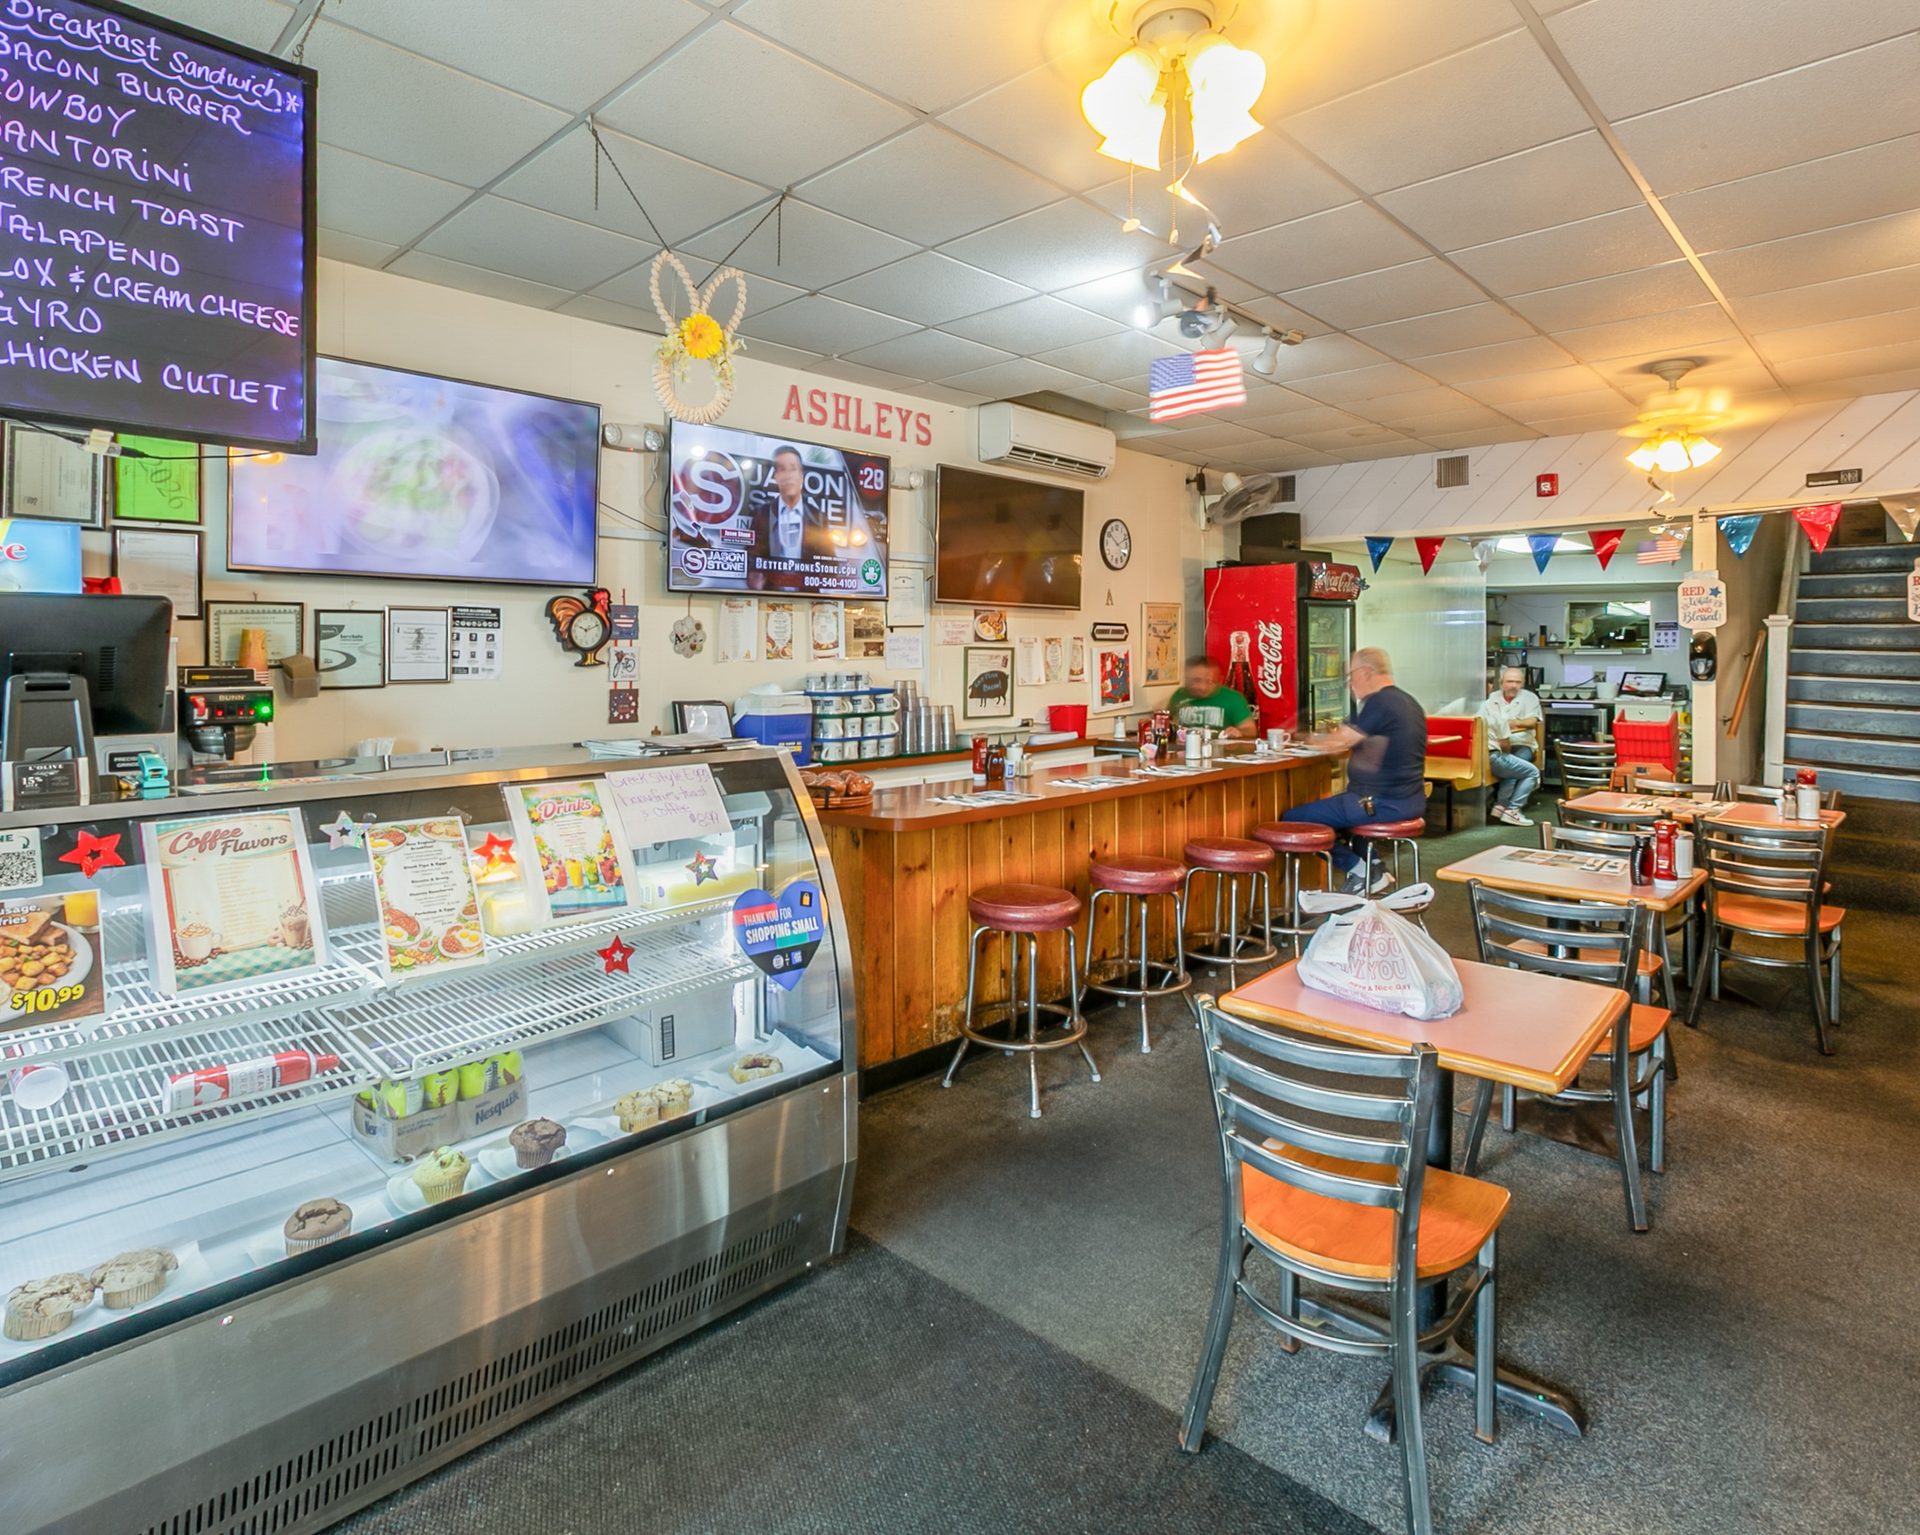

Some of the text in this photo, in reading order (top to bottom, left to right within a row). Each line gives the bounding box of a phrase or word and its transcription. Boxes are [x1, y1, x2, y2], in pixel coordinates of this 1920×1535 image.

[116, 72, 251, 135] BURGER
[0, 118, 192, 192] ANTORiNi
[0, 157, 244, 242] RENCH TOAST
[94, 272, 195, 313] CREAM
[200, 294, 300, 338] CHEESE
[0, 336, 287, 411] HiCKEN CUTLET
[782, 384, 932, 447] ASHLEYS
[749, 463, 845, 498] JAON
[708, 551, 745, 562] JASON
[708, 560, 745, 572] STONE
[804, 576, 858, 589] 800-540-4100
[1682, 586, 1705, 596] RED
[538, 798, 593, 820] Drinks
[168, 827, 244, 855] Coffee
[220, 834, 289, 857] Flavors
[0, 916, 28, 926] ries
[743, 906, 793, 927] THANK YOU FOR
[745, 916, 820, 945] SHOPPING SMALL
[11, 983, 86, 1015] $10.99
[475, 1089, 520, 1126] Nesquik
